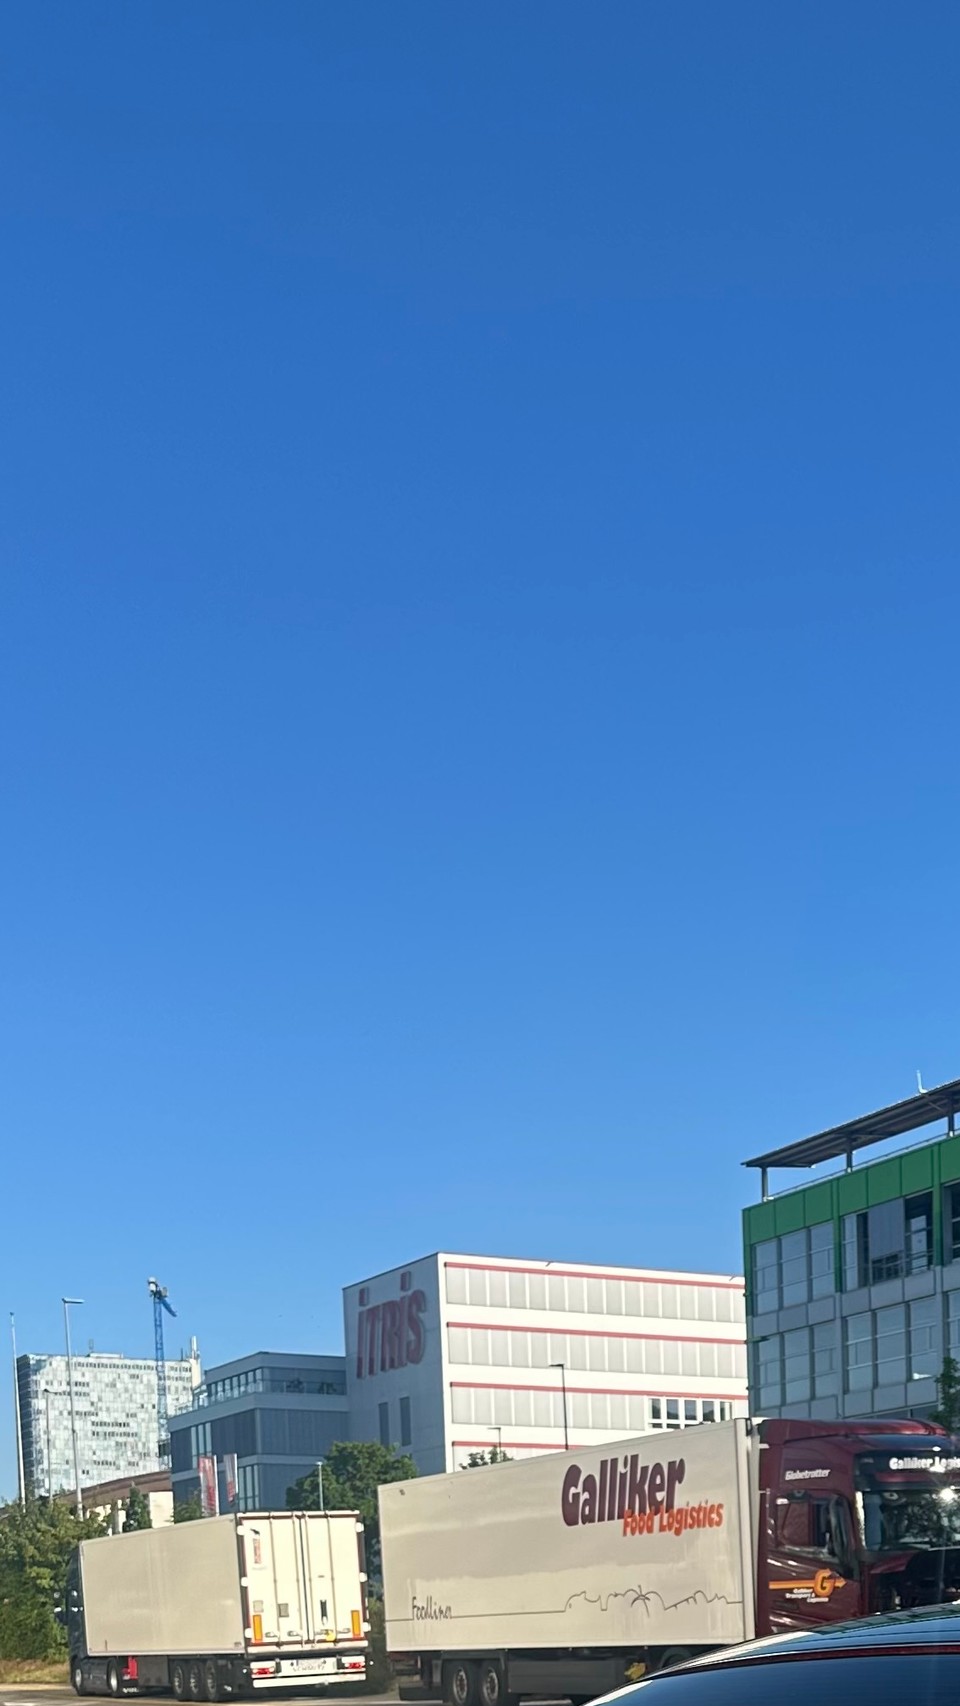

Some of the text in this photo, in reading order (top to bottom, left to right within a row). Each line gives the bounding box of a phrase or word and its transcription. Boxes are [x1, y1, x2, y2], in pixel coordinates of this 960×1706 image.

[785, 1468, 831, 1481] Globetrotter
[889, 1457, 933, 1470] Galliker
[562, 1454, 686, 1527] Galliker
[622, 1500, 724, 1537] Food Logistics
